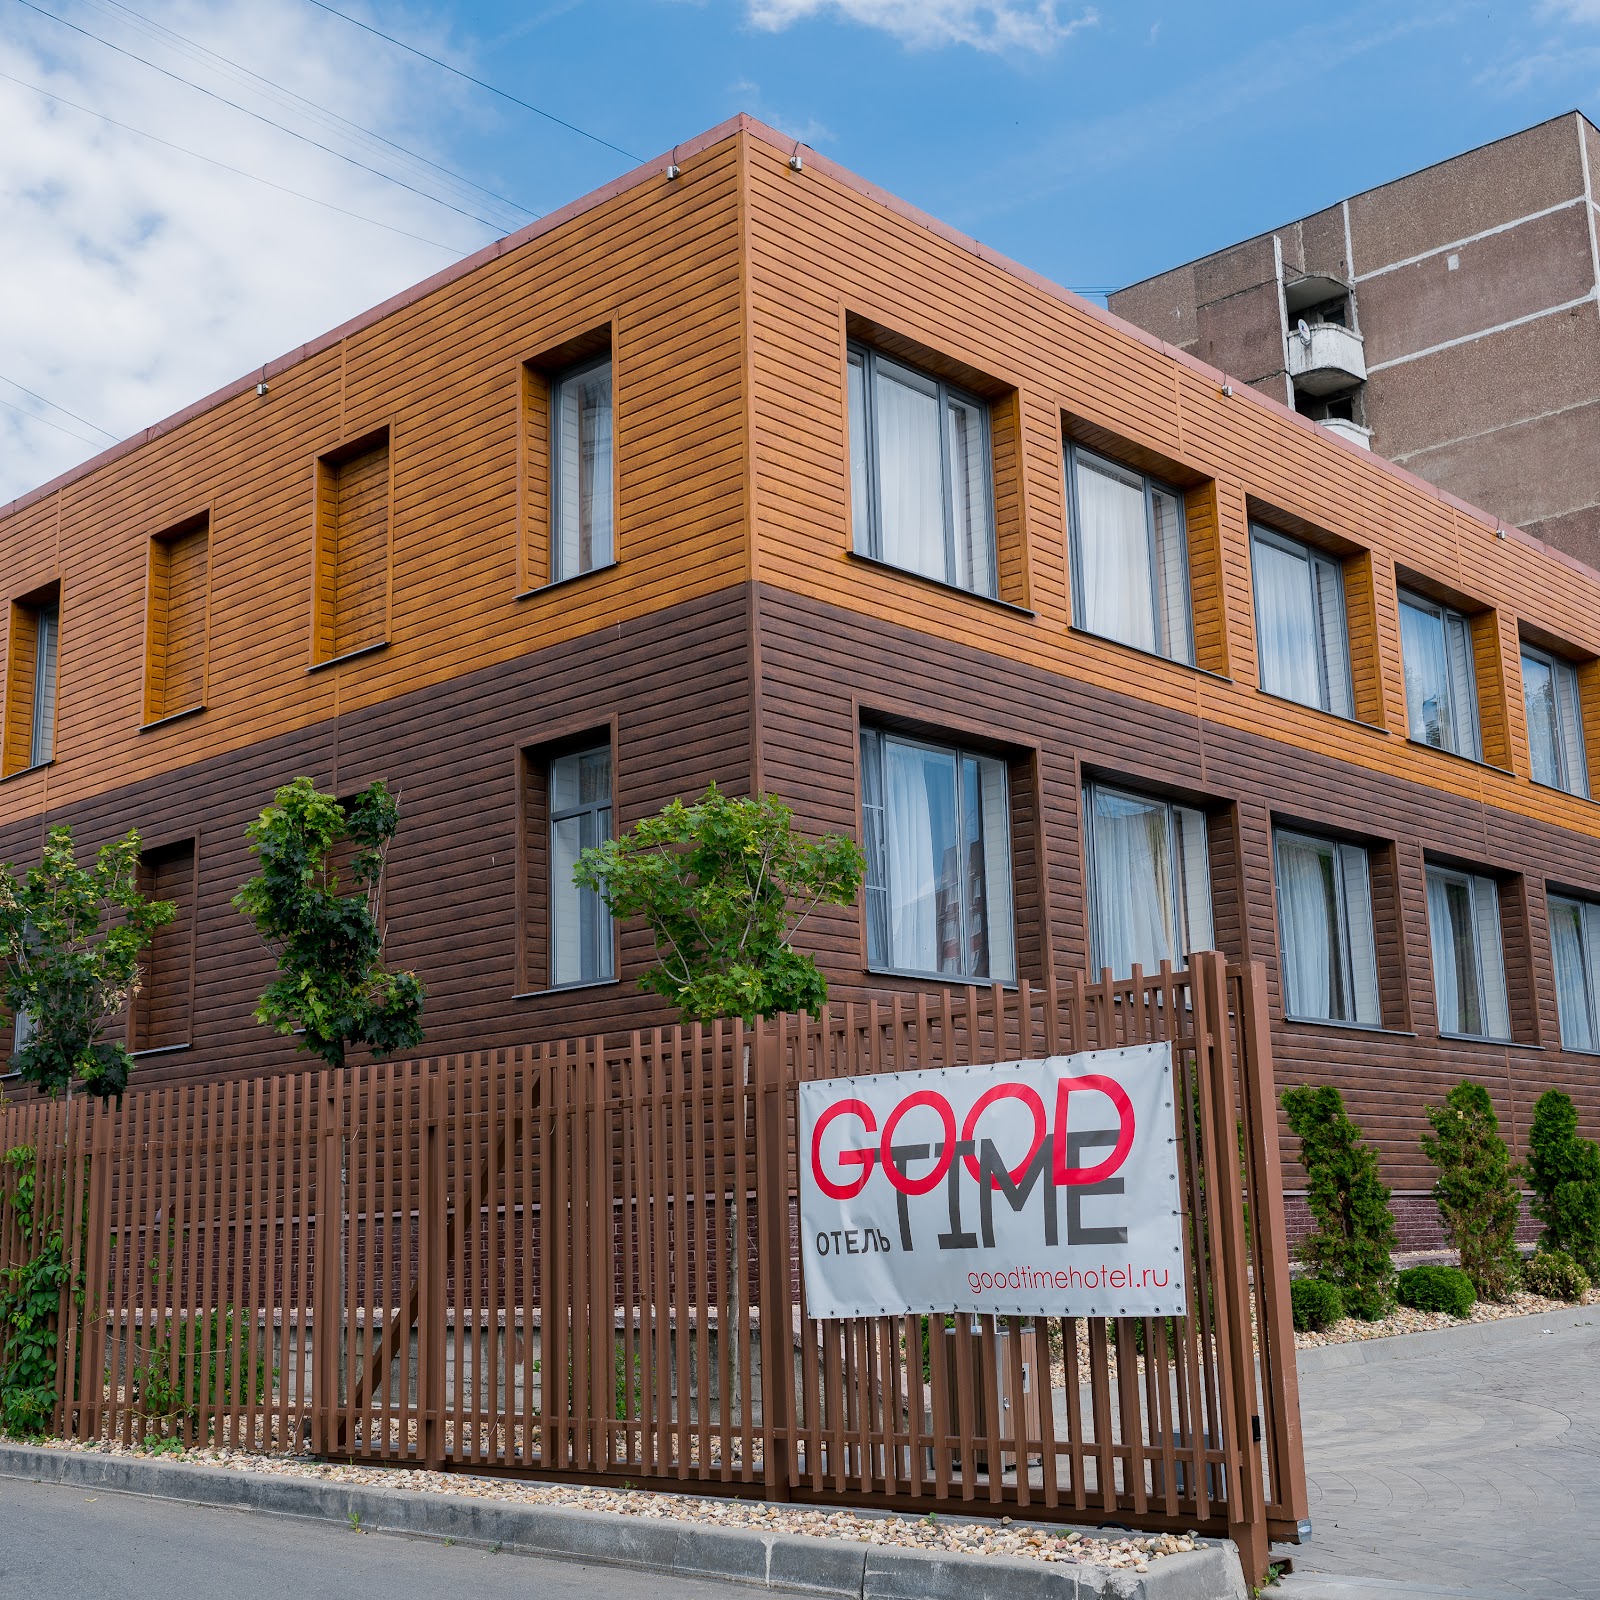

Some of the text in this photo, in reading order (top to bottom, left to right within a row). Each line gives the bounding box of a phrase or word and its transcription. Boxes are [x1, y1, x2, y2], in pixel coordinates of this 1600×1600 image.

[811, 1074, 1135, 1200] GOOD
[873, 1129, 1128, 1251] TIME
[816, 1229, 891, 1256] ОТЕЛЬ
[967, 1264, 1168, 1294] goodtimehotel.ru
